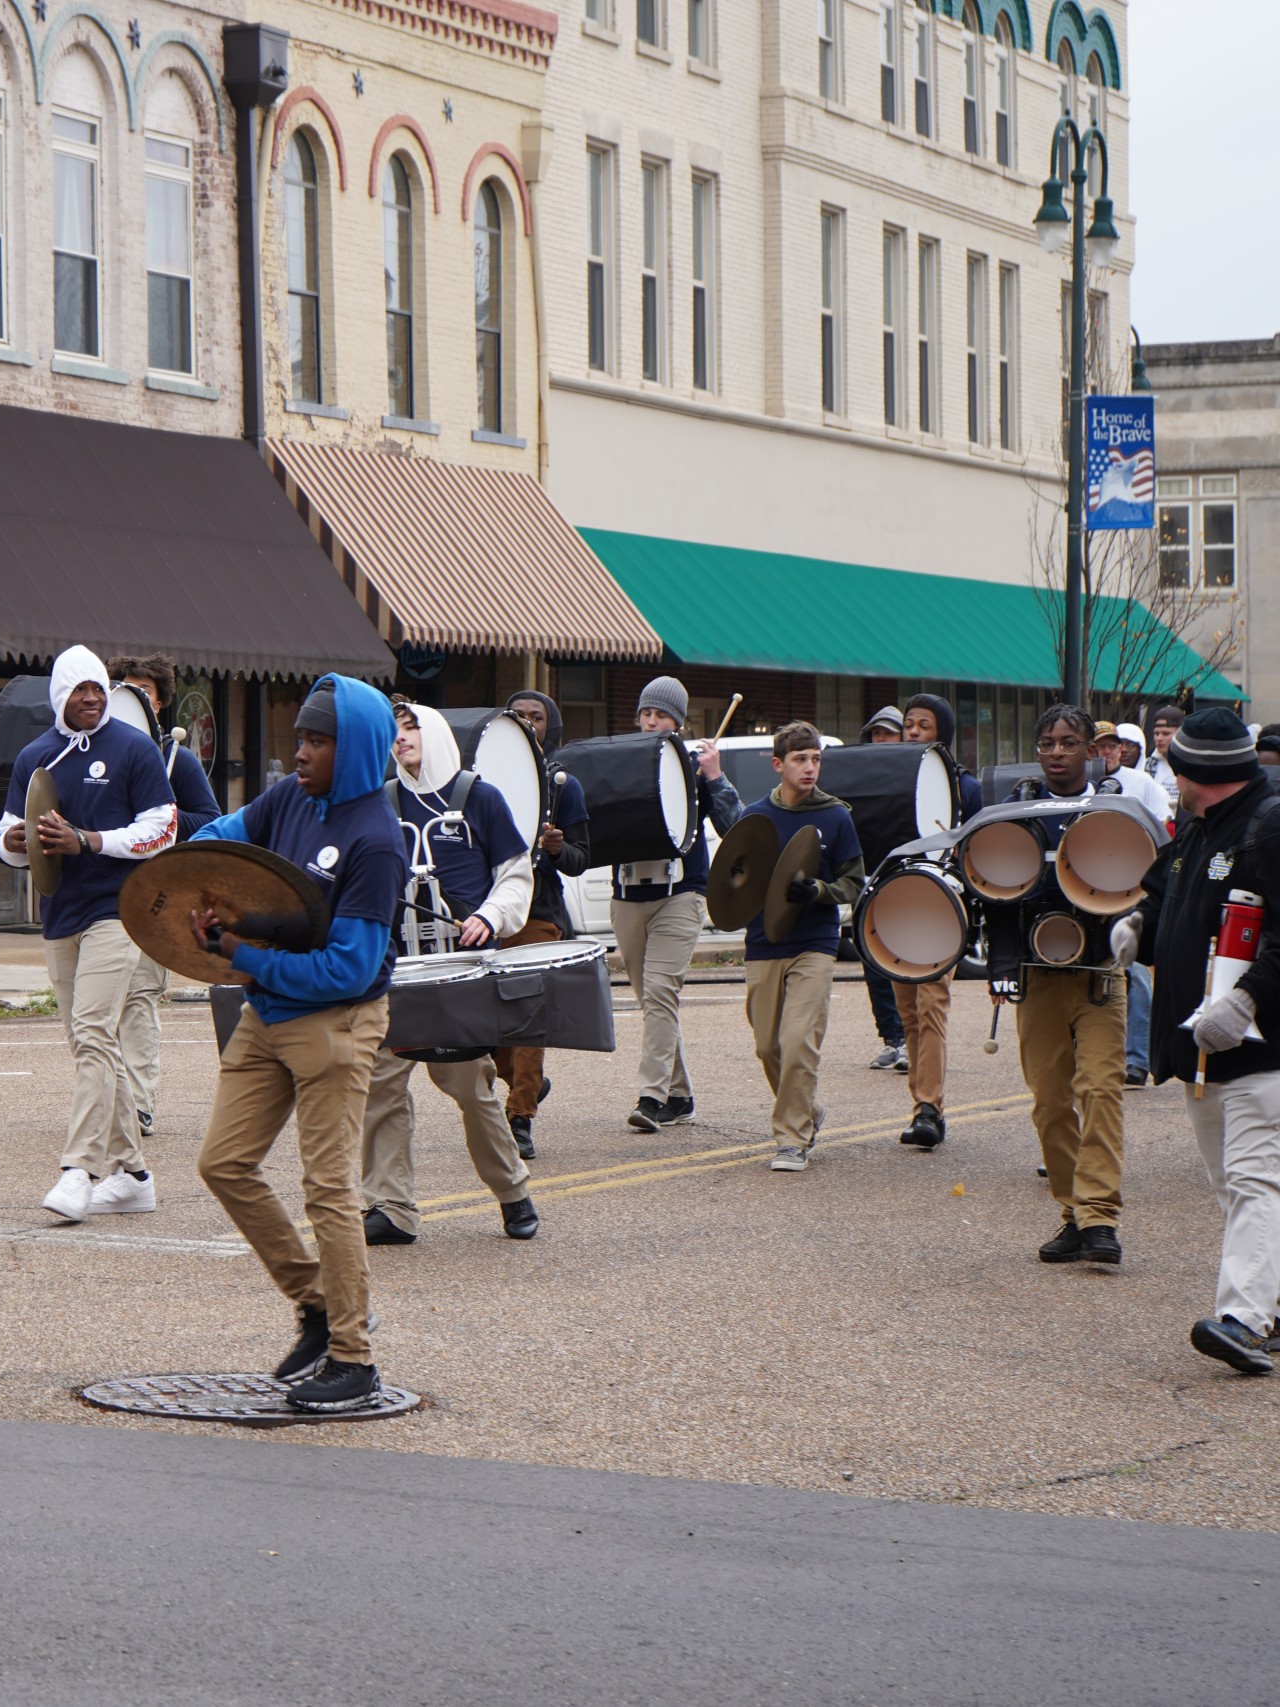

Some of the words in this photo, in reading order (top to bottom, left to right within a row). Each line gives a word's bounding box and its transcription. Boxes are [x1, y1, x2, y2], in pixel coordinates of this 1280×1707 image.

[1092, 407, 1133, 428] Home
[1133, 412, 1147, 429] of
[1093, 427, 1109, 440] the
[1108, 424, 1152, 446] Brave
[150, 890, 168, 916] ZBT
